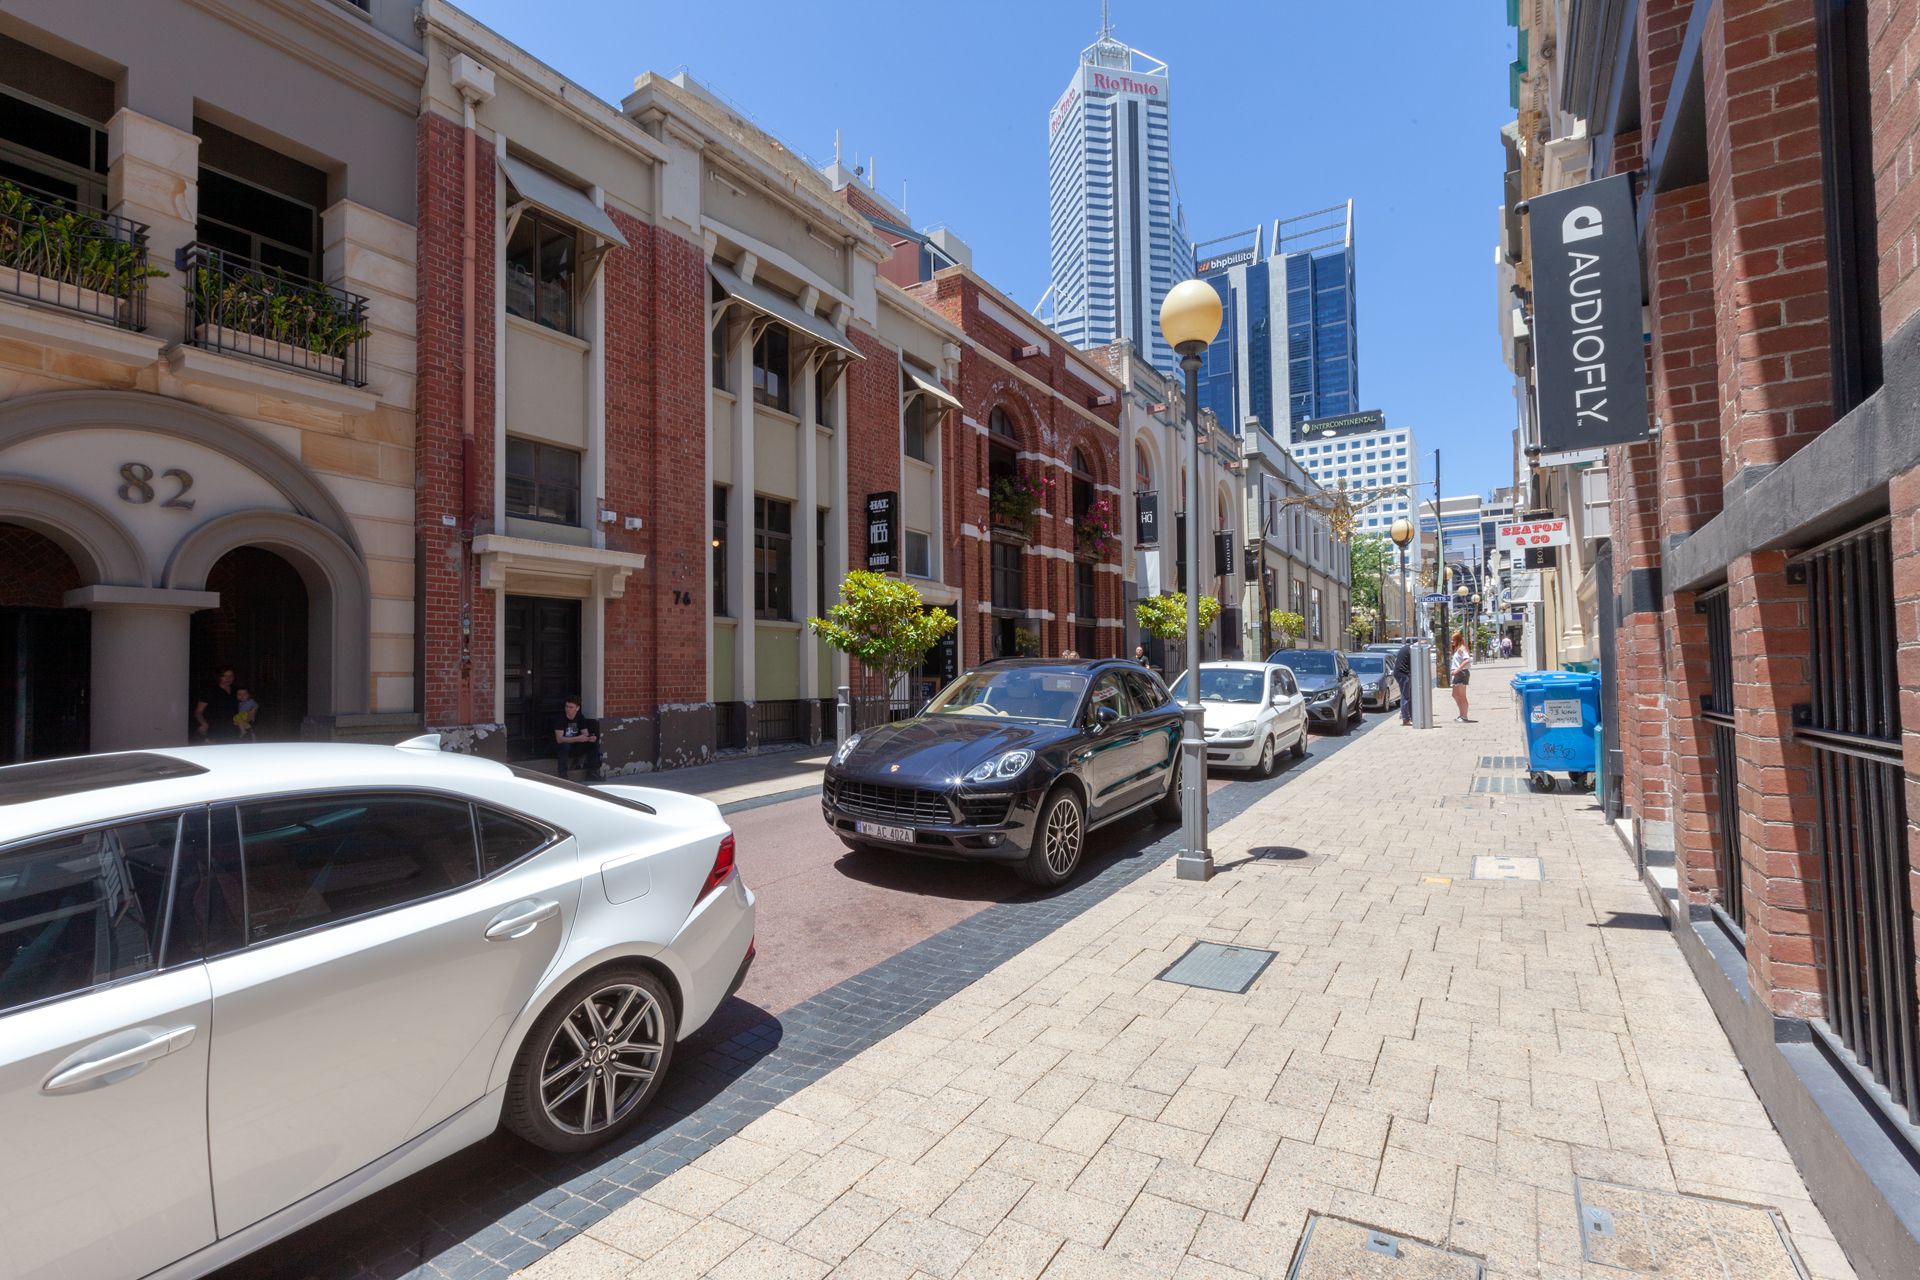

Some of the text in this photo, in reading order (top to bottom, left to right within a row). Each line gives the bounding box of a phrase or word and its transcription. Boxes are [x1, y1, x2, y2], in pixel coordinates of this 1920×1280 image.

[1568, 251, 1609, 423] AUDIOFLY
[118, 462, 196, 511] 82
[1502, 522, 1564, 536] SEATON
[1516, 535, 1550, 545] & CO
[869, 555, 890, 566] BARBER
[673, 590, 691, 606] 76
